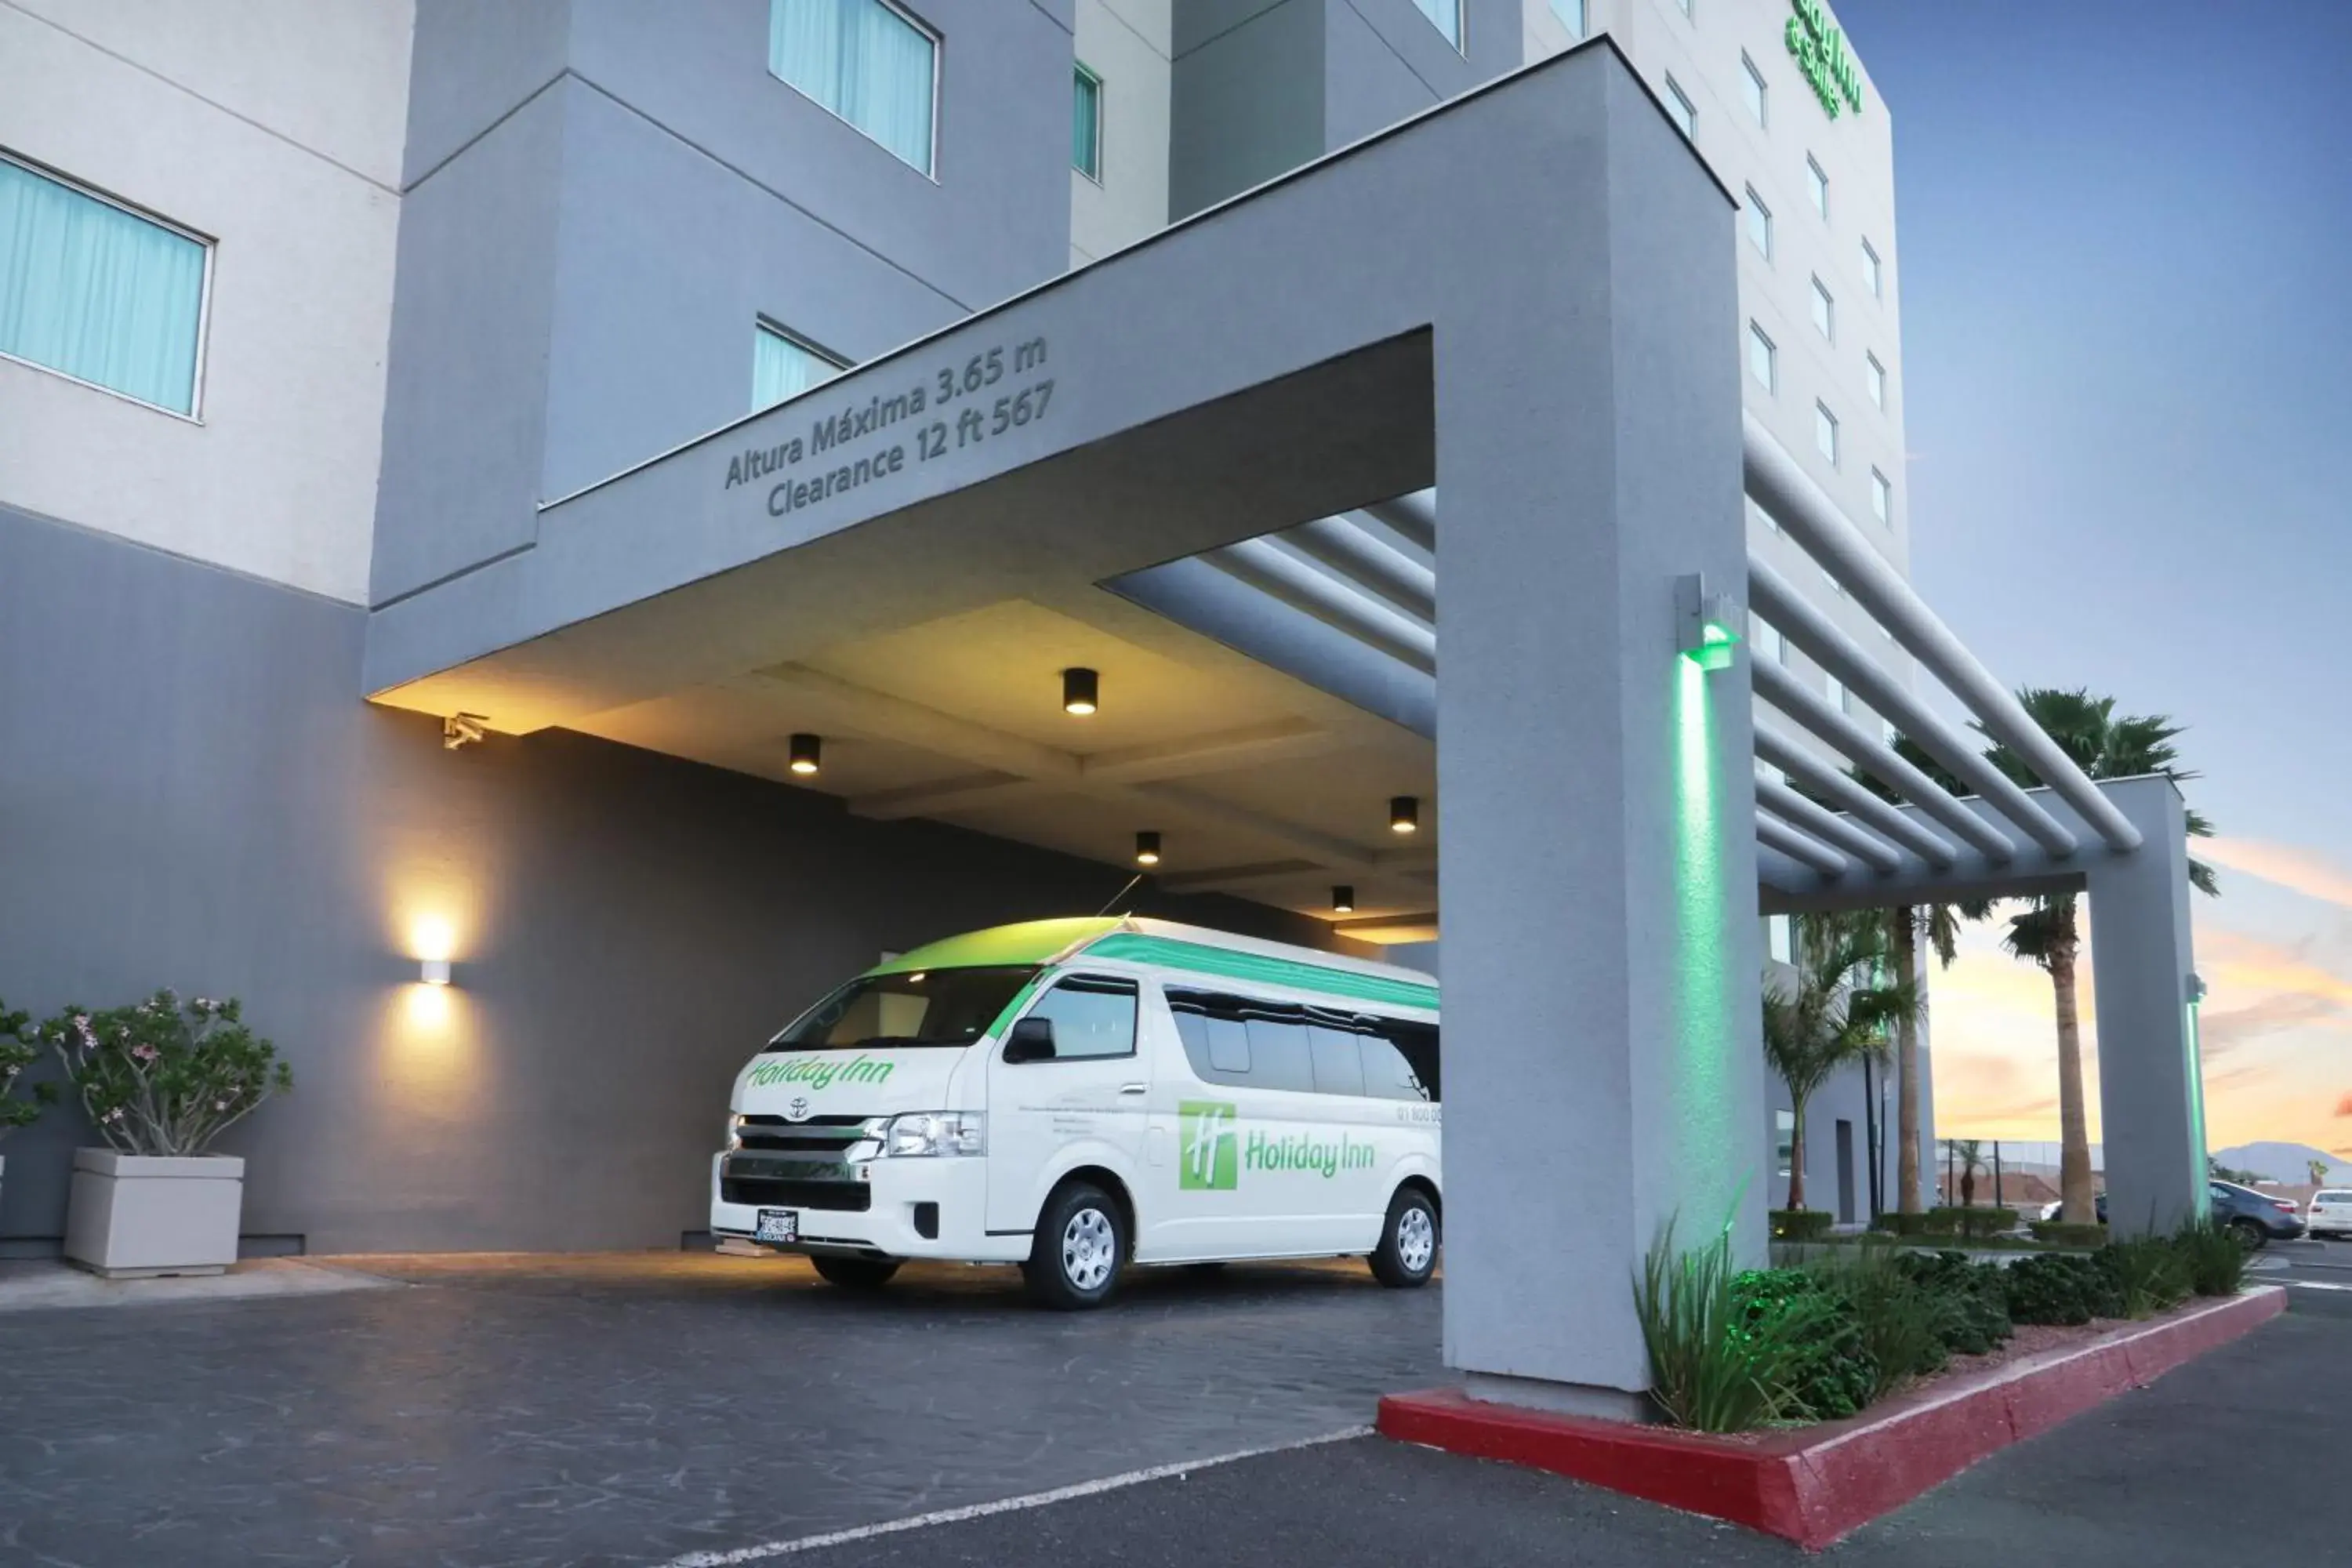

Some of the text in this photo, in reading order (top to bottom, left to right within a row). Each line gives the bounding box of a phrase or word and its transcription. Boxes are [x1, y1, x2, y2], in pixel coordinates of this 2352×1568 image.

[725, 336, 1047, 490] Altura Máxima 3.65 m
[768, 378, 1054, 517] Clearance 12 ft 567
[747, 1054, 895, 1091] Holiday Inn
[1245, 1130, 1375, 1178] Holiday Inn
